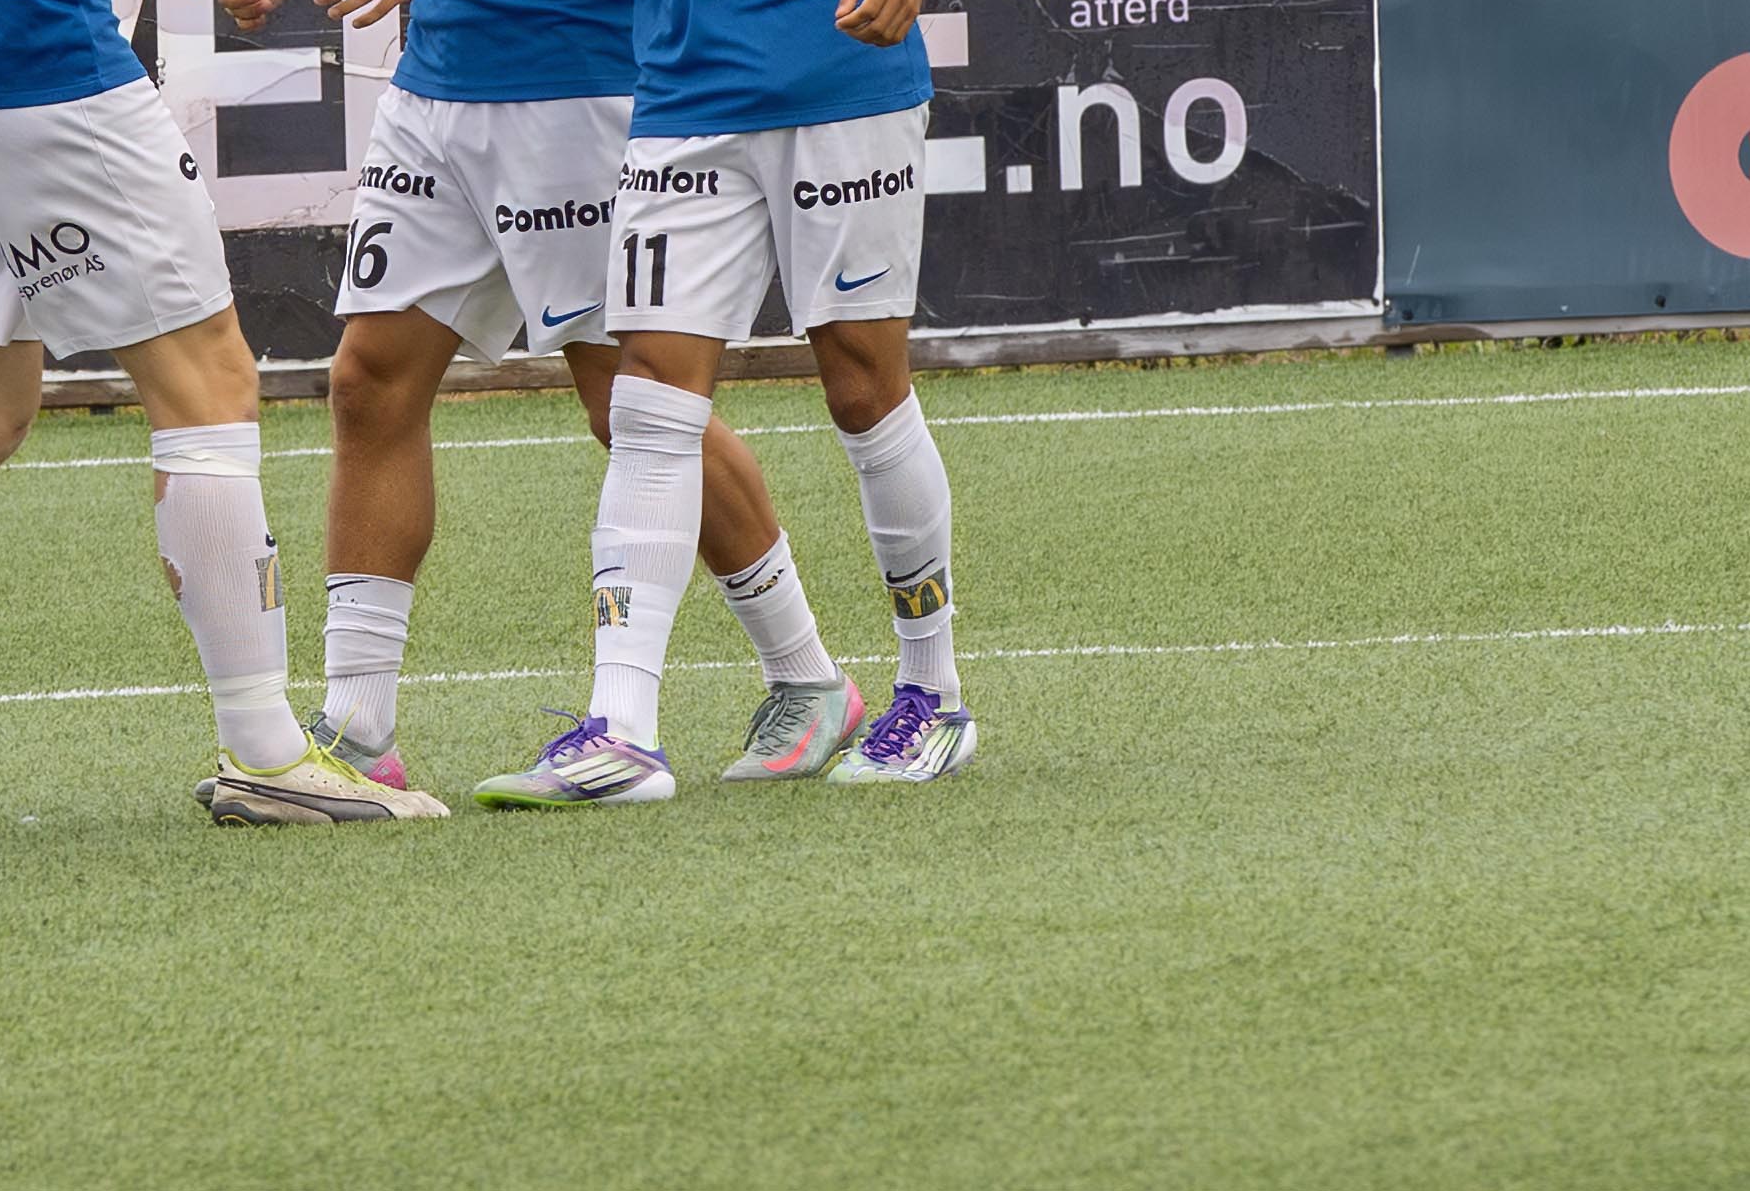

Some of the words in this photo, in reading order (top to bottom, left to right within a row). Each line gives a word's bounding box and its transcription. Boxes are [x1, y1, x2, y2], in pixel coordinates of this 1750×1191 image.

[794, 164, 914, 210] Comfort
[0, 222, 90, 278] MO
[623, 232, 668, 308] 11
[18, 264, 80, 301] prenør
[85, 254, 105, 274] AS
